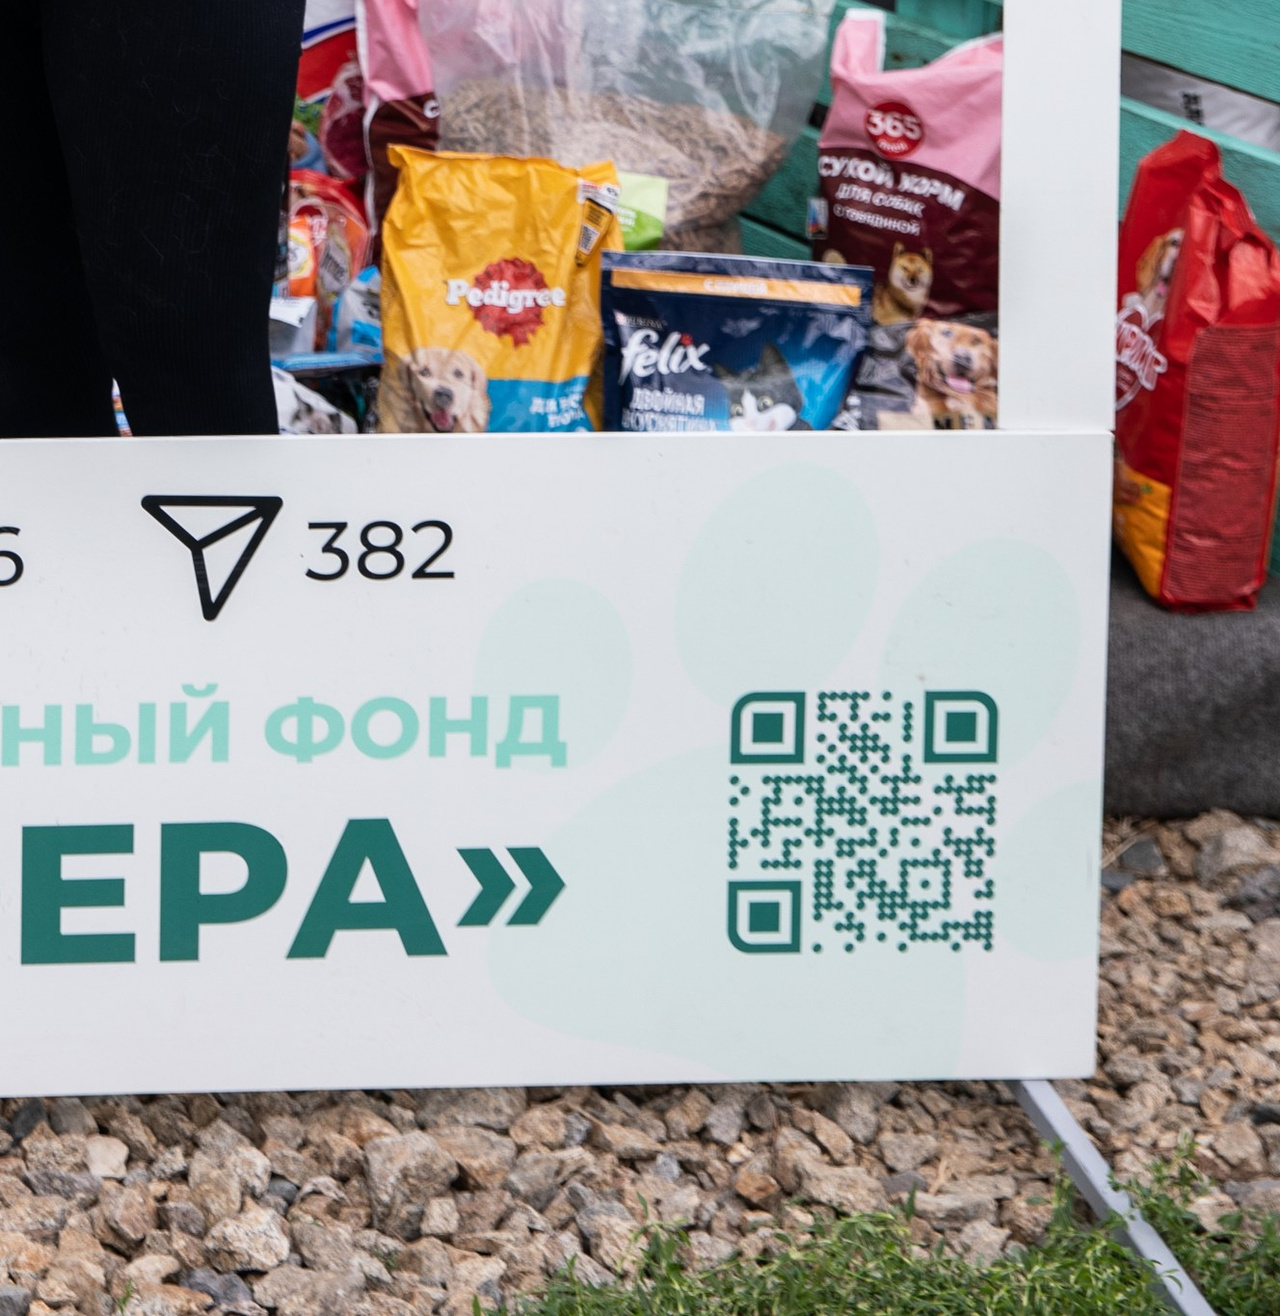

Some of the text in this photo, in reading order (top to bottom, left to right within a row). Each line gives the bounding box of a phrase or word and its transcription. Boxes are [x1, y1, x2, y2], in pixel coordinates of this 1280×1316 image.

[865, 108, 922, 141] 365
[817, 155, 966, 212] СУХОЙ КОРМ
[446, 278, 567, 314] Pedigree
[618, 327, 712, 387] felix
[305, 519, 457, 582] 382
[263, 693, 568, 771] ФОНД
